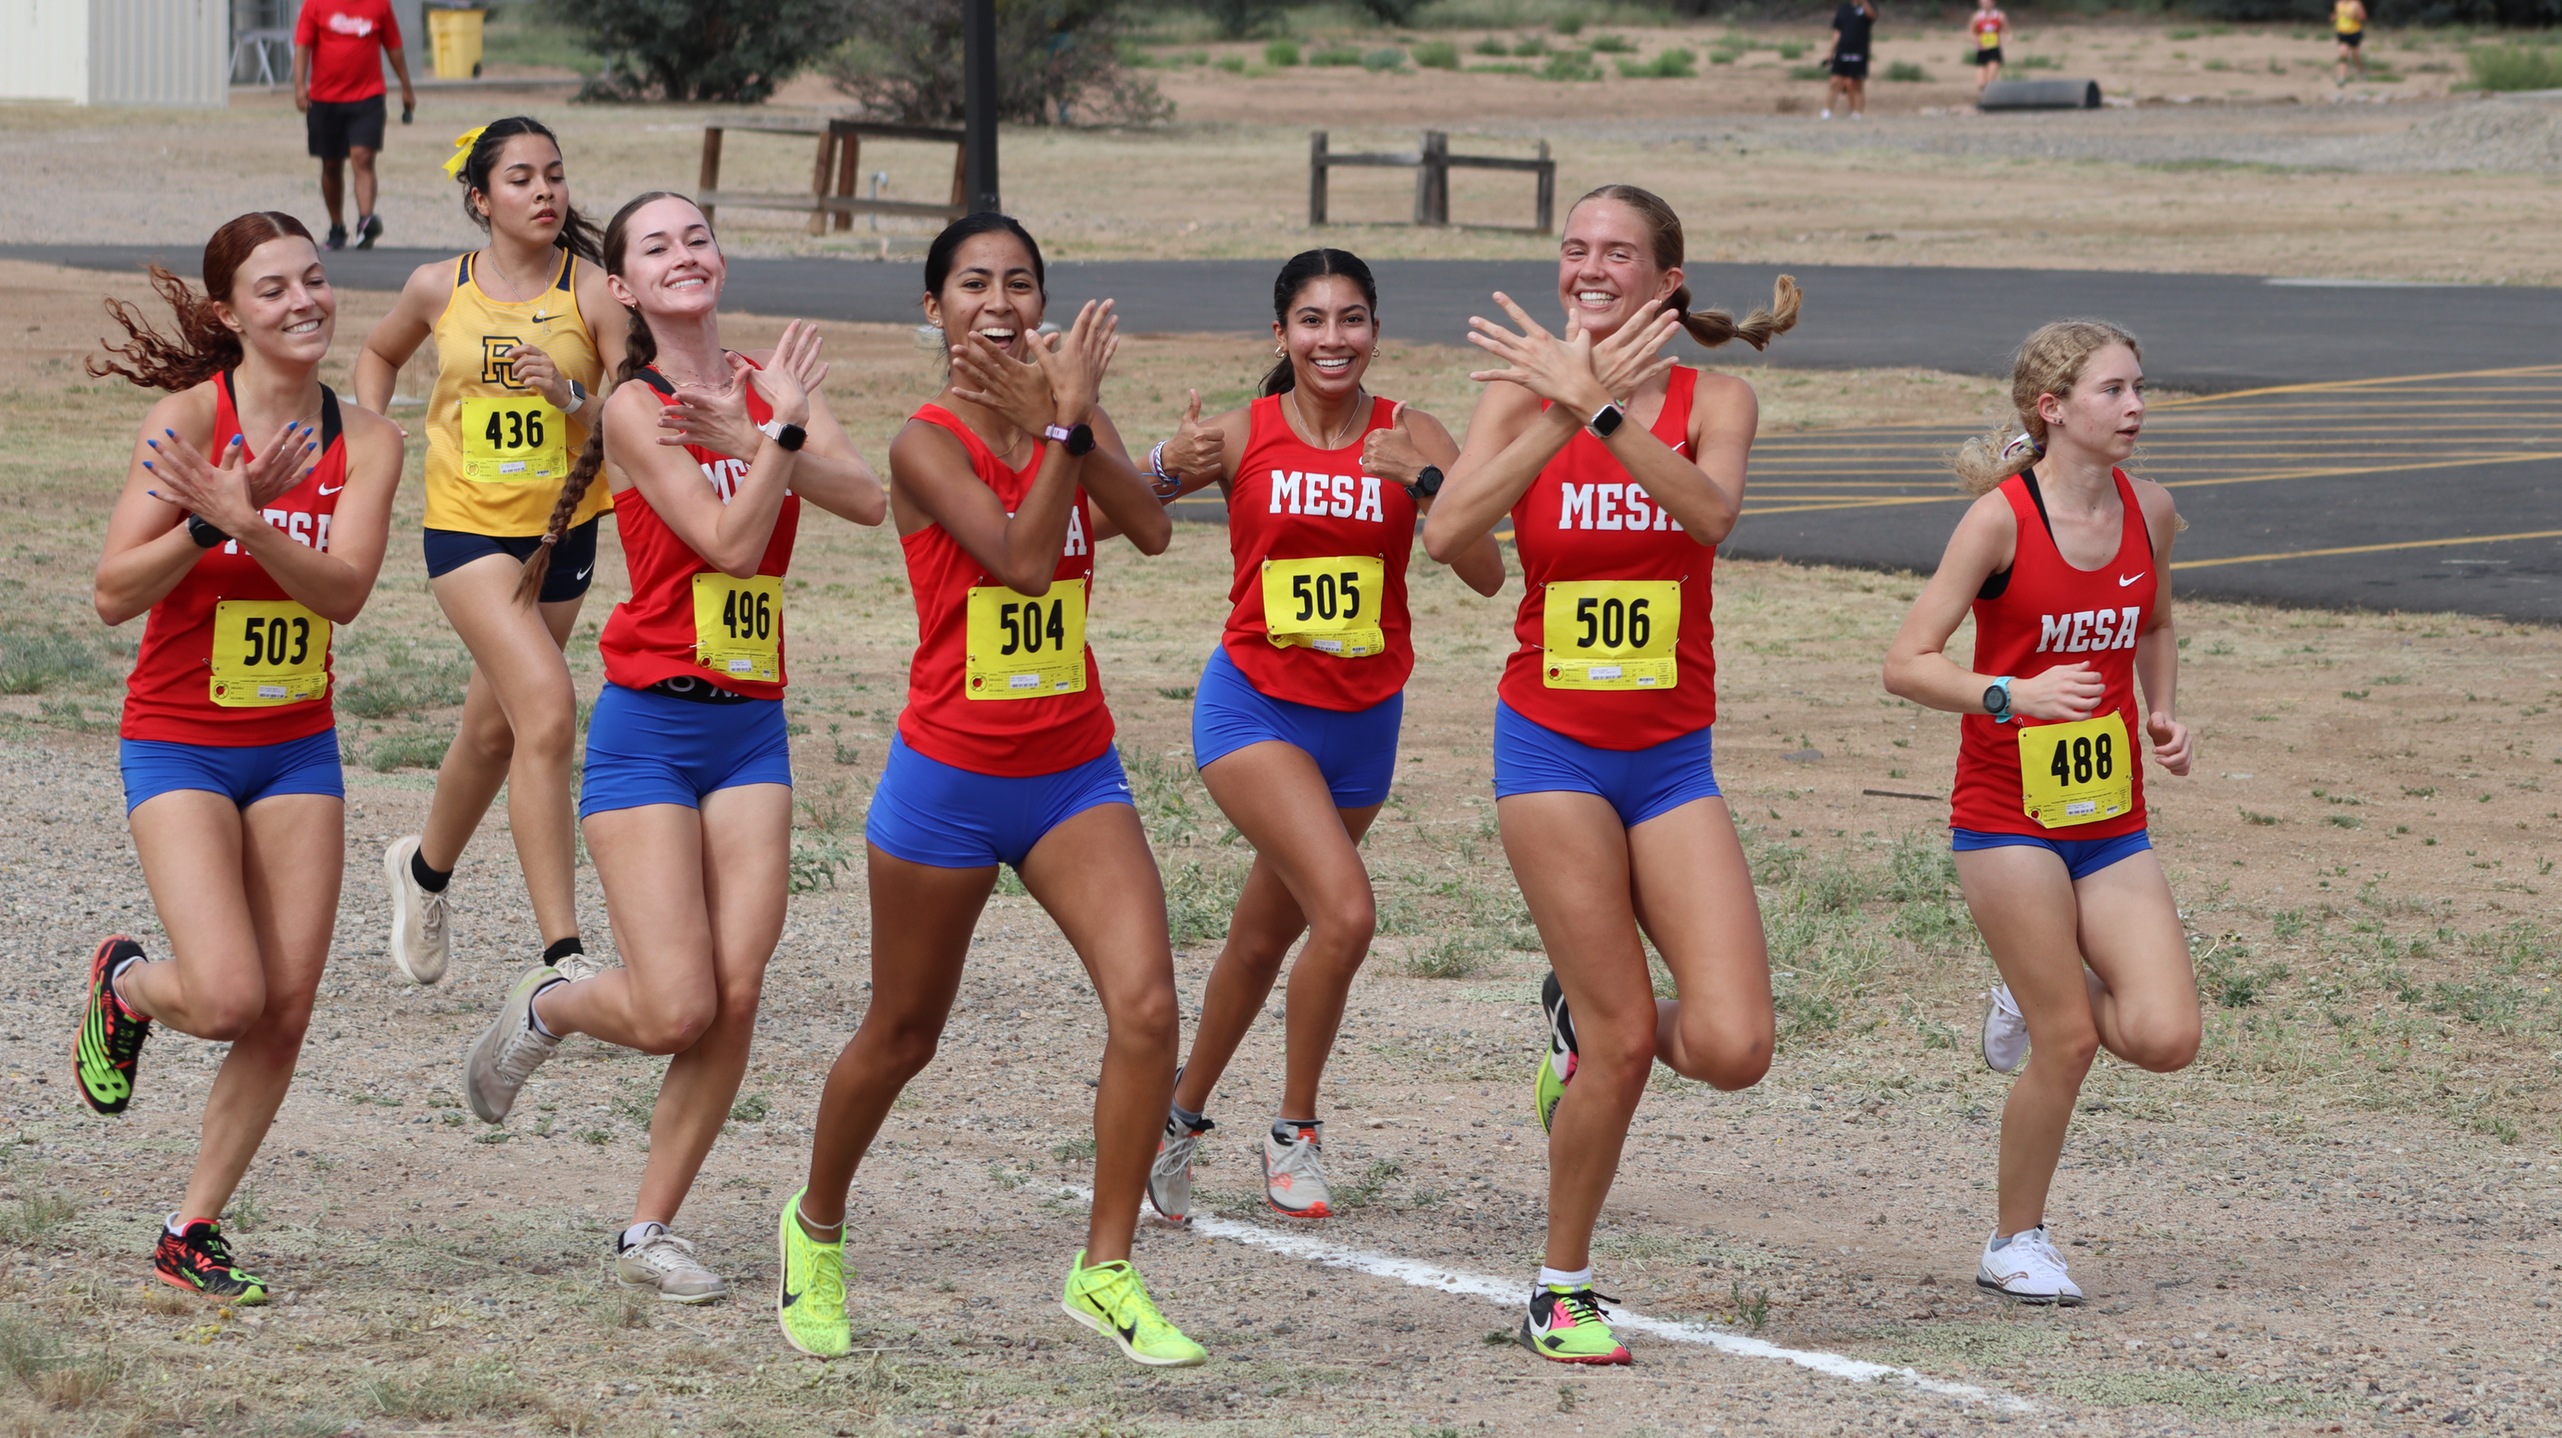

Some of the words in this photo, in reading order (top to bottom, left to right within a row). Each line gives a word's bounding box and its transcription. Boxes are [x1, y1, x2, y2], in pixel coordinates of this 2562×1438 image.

[486, 410, 544, 450] 436
[1269, 470, 1384, 523] MESA
[723, 590, 770, 640] 496
[1293, 572, 1360, 621] 505
[243, 617, 310, 666] 503
[1001, 599, 1064, 655] 504
[1577, 598, 1650, 649] 506
[2036, 606, 2141, 653] MESA
[2051, 733, 2113, 786] 488
